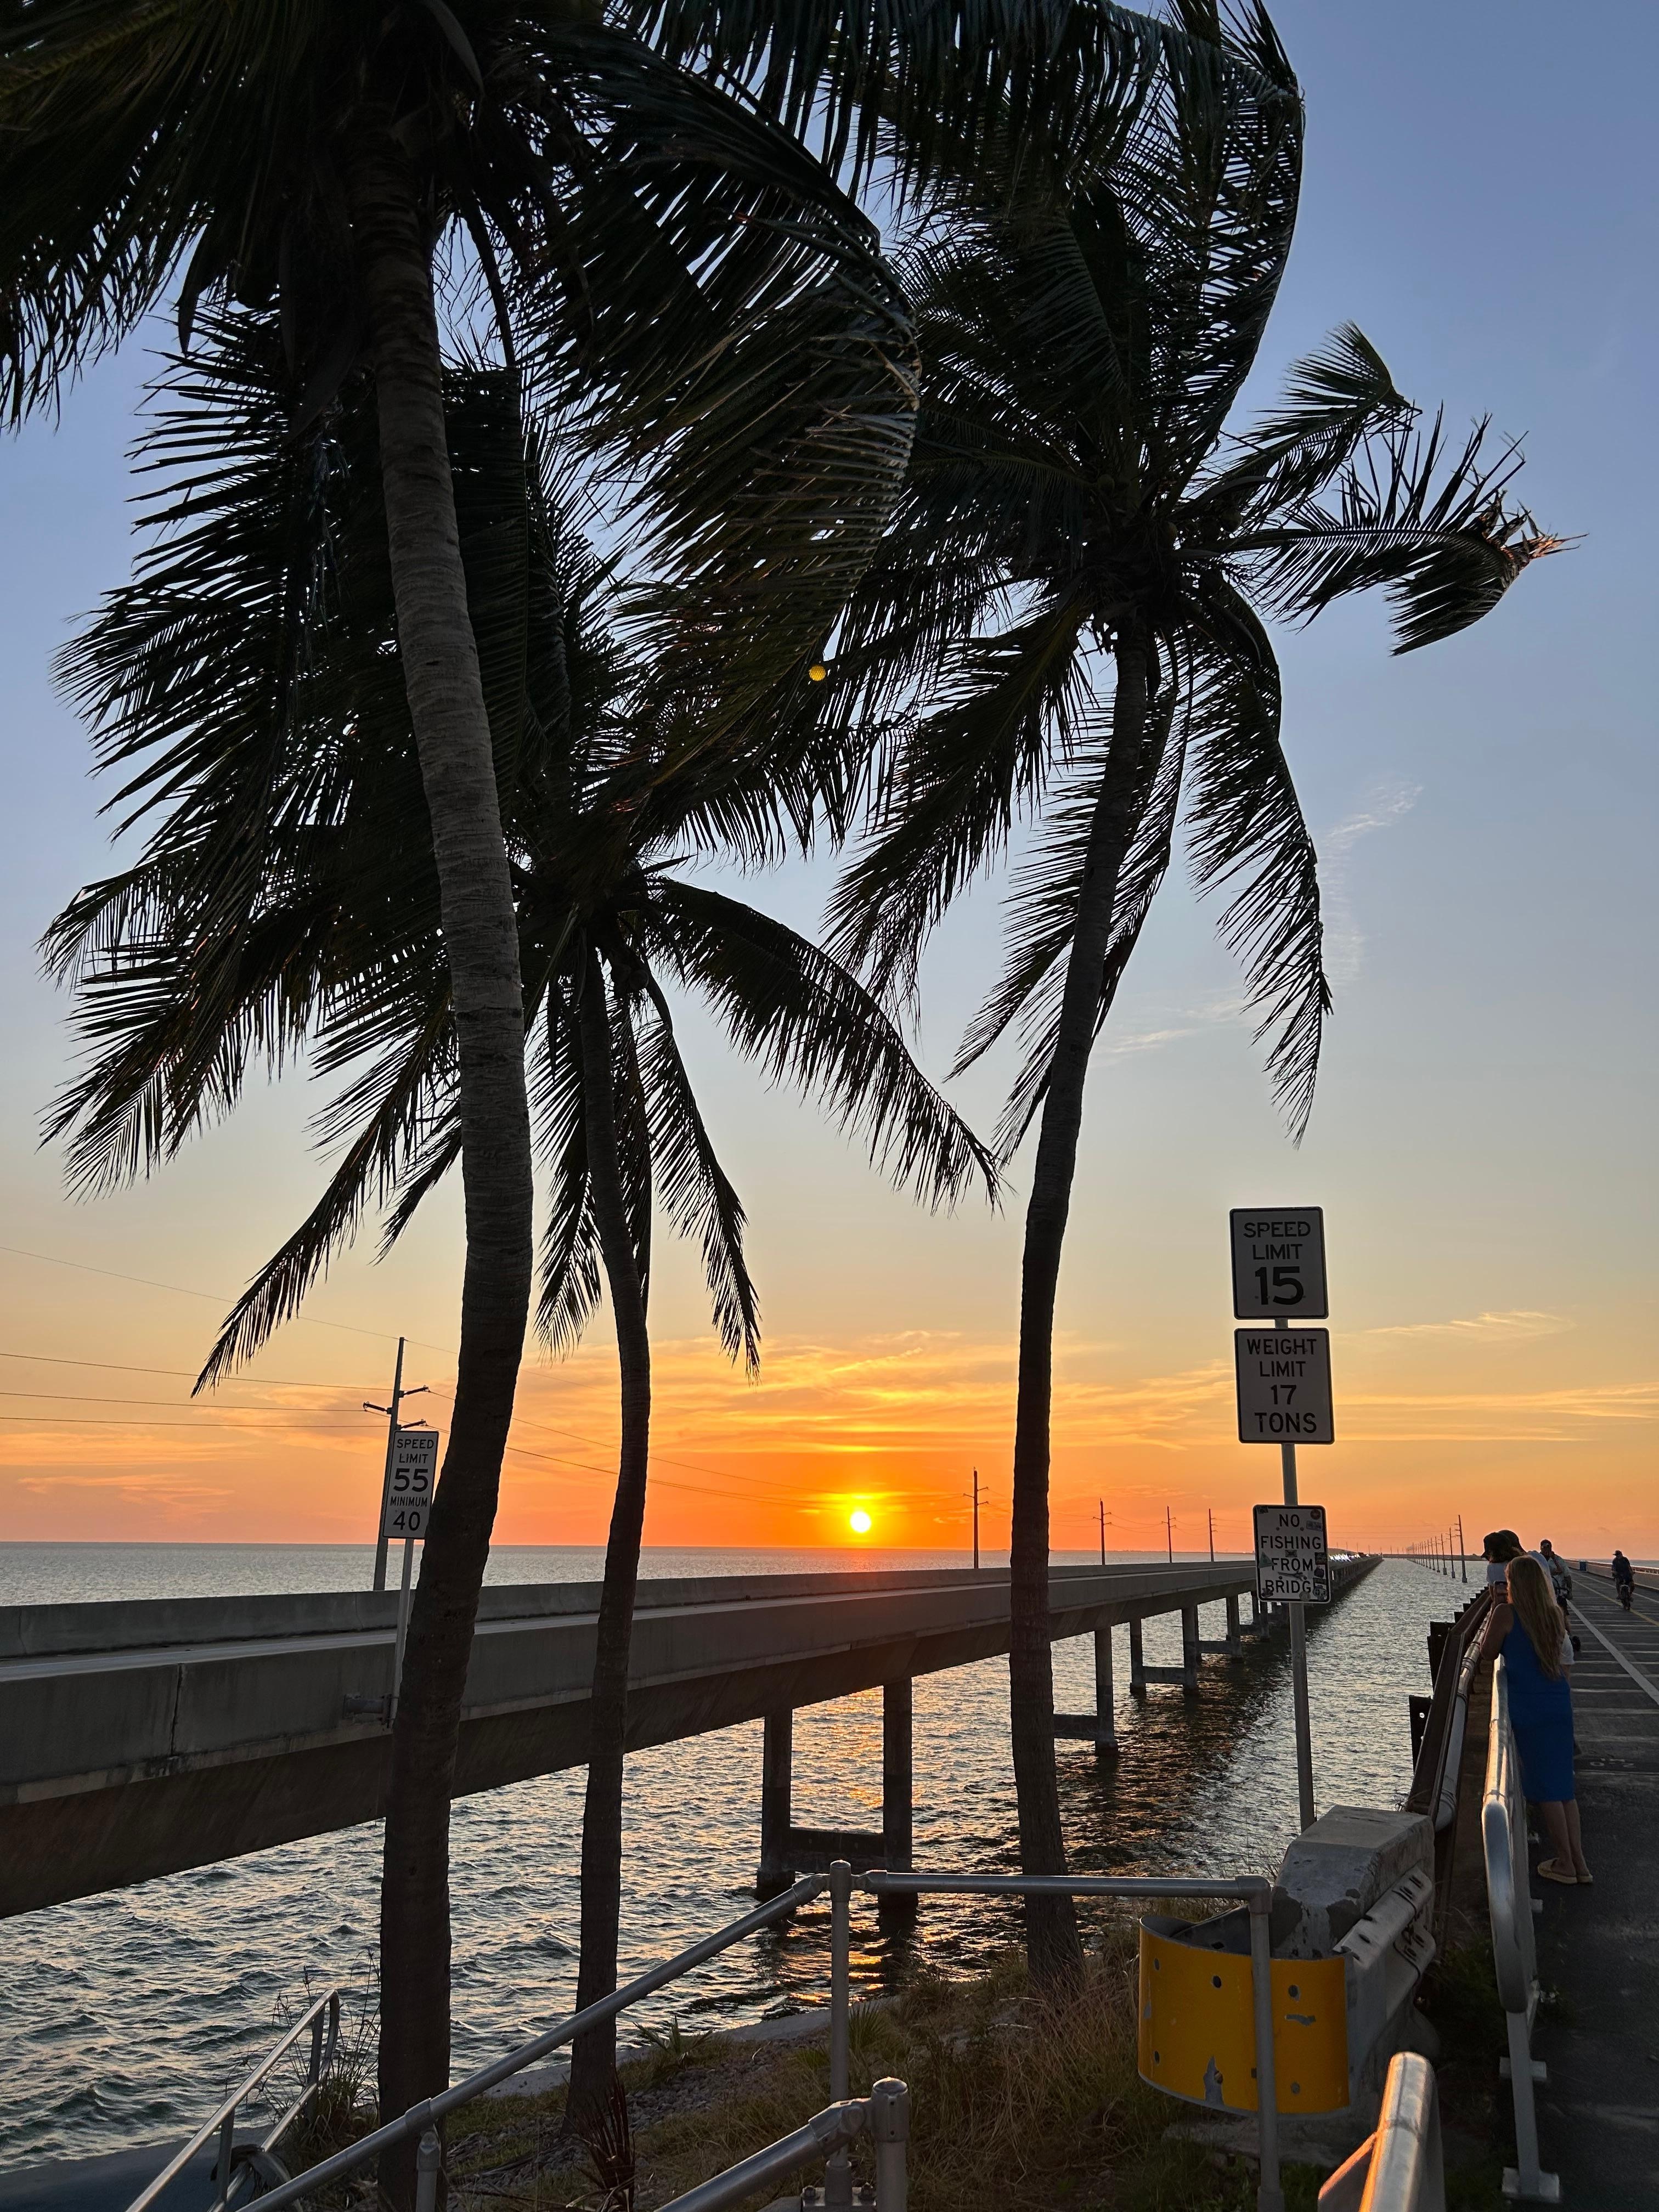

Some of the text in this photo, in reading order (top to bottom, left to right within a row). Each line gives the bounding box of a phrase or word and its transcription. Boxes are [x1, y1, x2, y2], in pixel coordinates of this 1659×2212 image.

[1243, 1221, 1311, 1238] SPEED
[1252, 1244, 1303, 1260] LIMIT
[1255, 1266, 1304, 1305] 15
[1246, 1338, 1317, 1355] WEIGHT
[1259, 1361, 1306, 1377] LIMIT
[1270, 1384, 1297, 1405] 17
[1254, 1412, 1317, 1434] TONS
[397, 1438, 434, 1449] SPEED
[399, 1453, 428, 1464] LIMIT
[393, 1468, 428, 1492] 55
[390, 1496, 428, 1508] MINIMUM
[393, 1511, 421, 1531] 40
[1279, 1514, 1300, 1527] NO
[1261, 1536, 1321, 1550] FISHING
[1271, 1558, 1313, 1572] FROM
